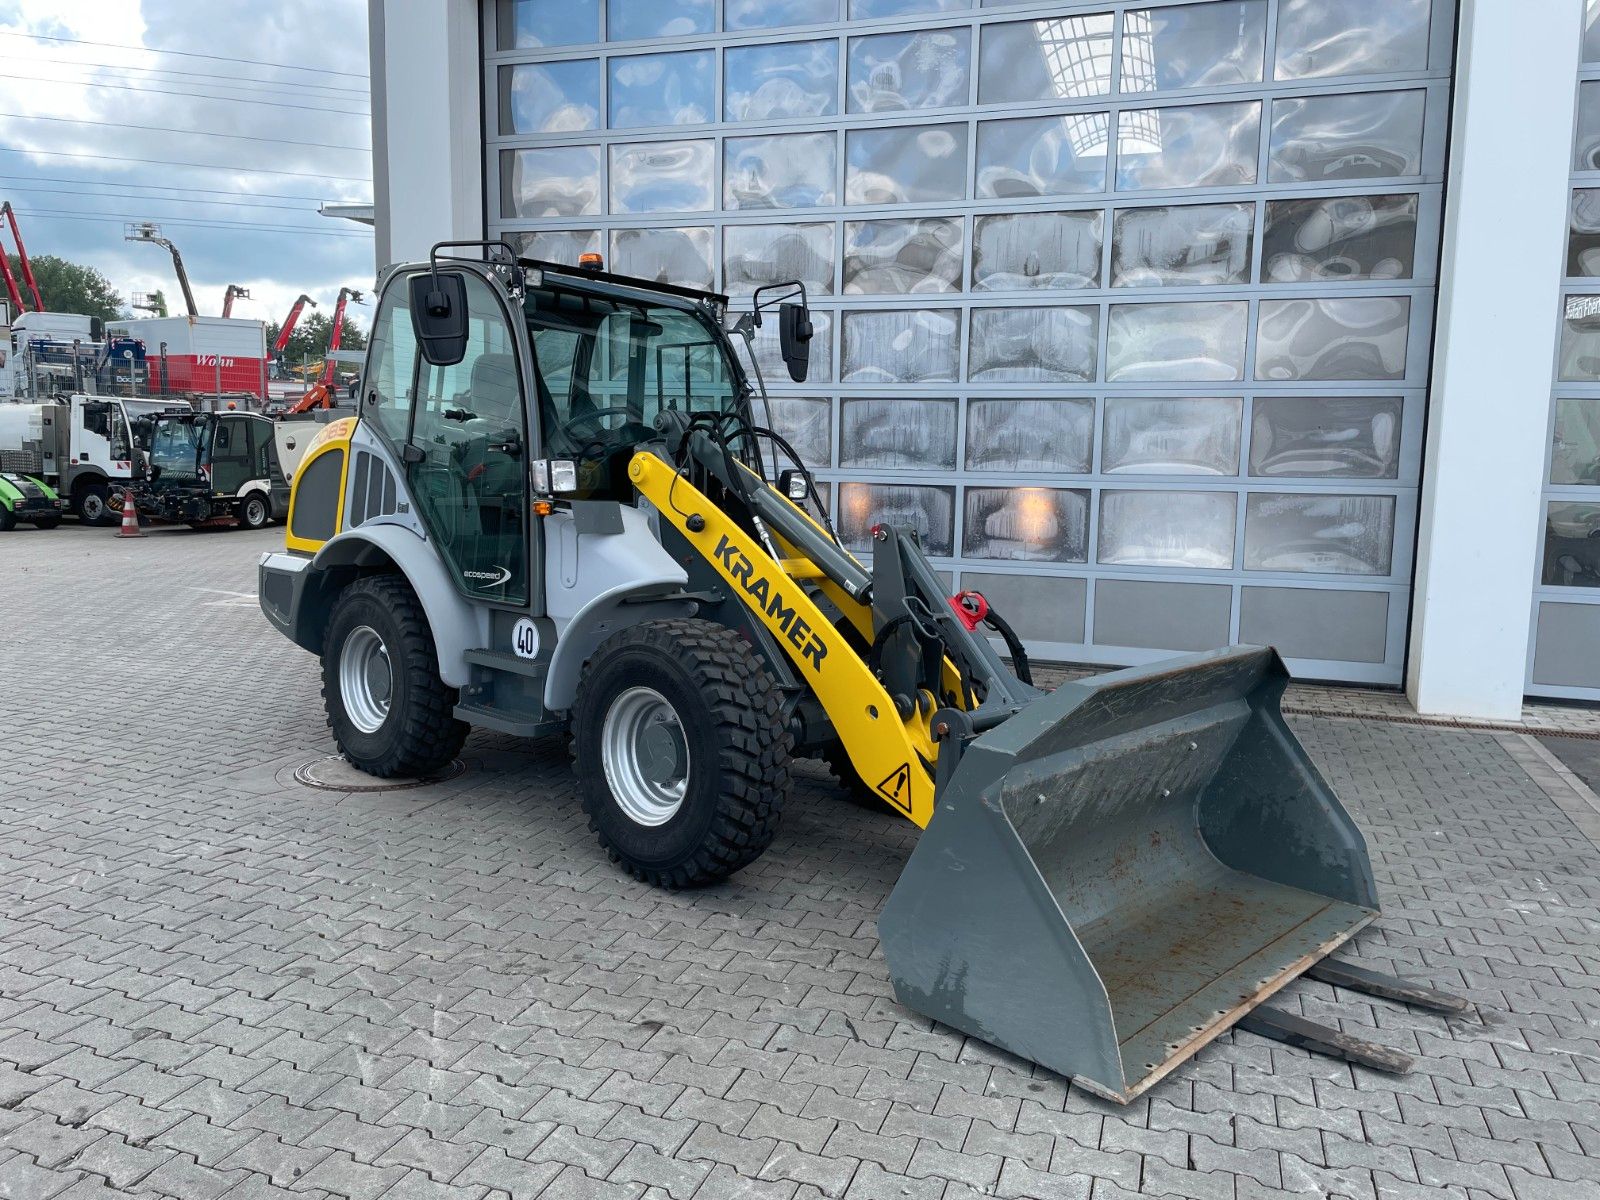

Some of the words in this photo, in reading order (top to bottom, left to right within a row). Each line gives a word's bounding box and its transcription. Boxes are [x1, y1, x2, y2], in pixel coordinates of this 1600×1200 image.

[463, 570, 501, 580] ecospeed
[713, 533, 828, 674] KRAMER
[517, 625, 533, 655] 40
